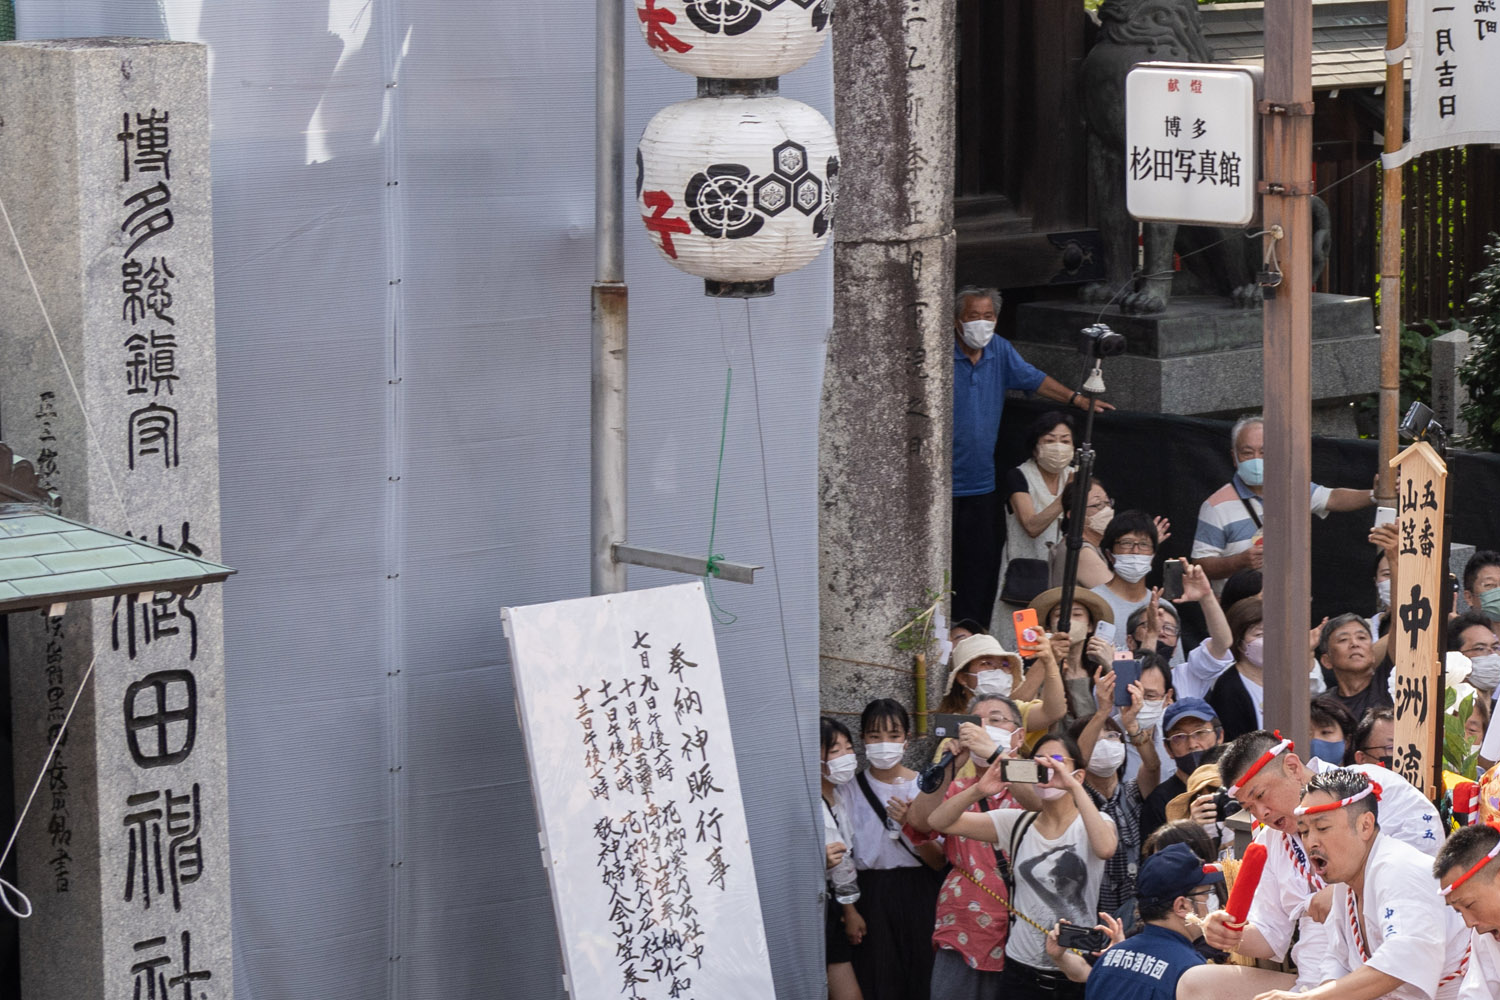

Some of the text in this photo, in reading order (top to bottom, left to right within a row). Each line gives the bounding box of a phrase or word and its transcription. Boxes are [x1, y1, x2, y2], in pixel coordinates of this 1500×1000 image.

[1165, 115, 1207, 139] 博多
[1130, 145, 1242, 187] 杉田写真館
[643, 190, 692, 259] 子
[1400, 479, 1418, 556] 山笠
[1419, 479, 1438, 558] 五番
[1395, 583, 1433, 793] 中洲流
[1102, 948, 1169, 980] 福岡市消防団
